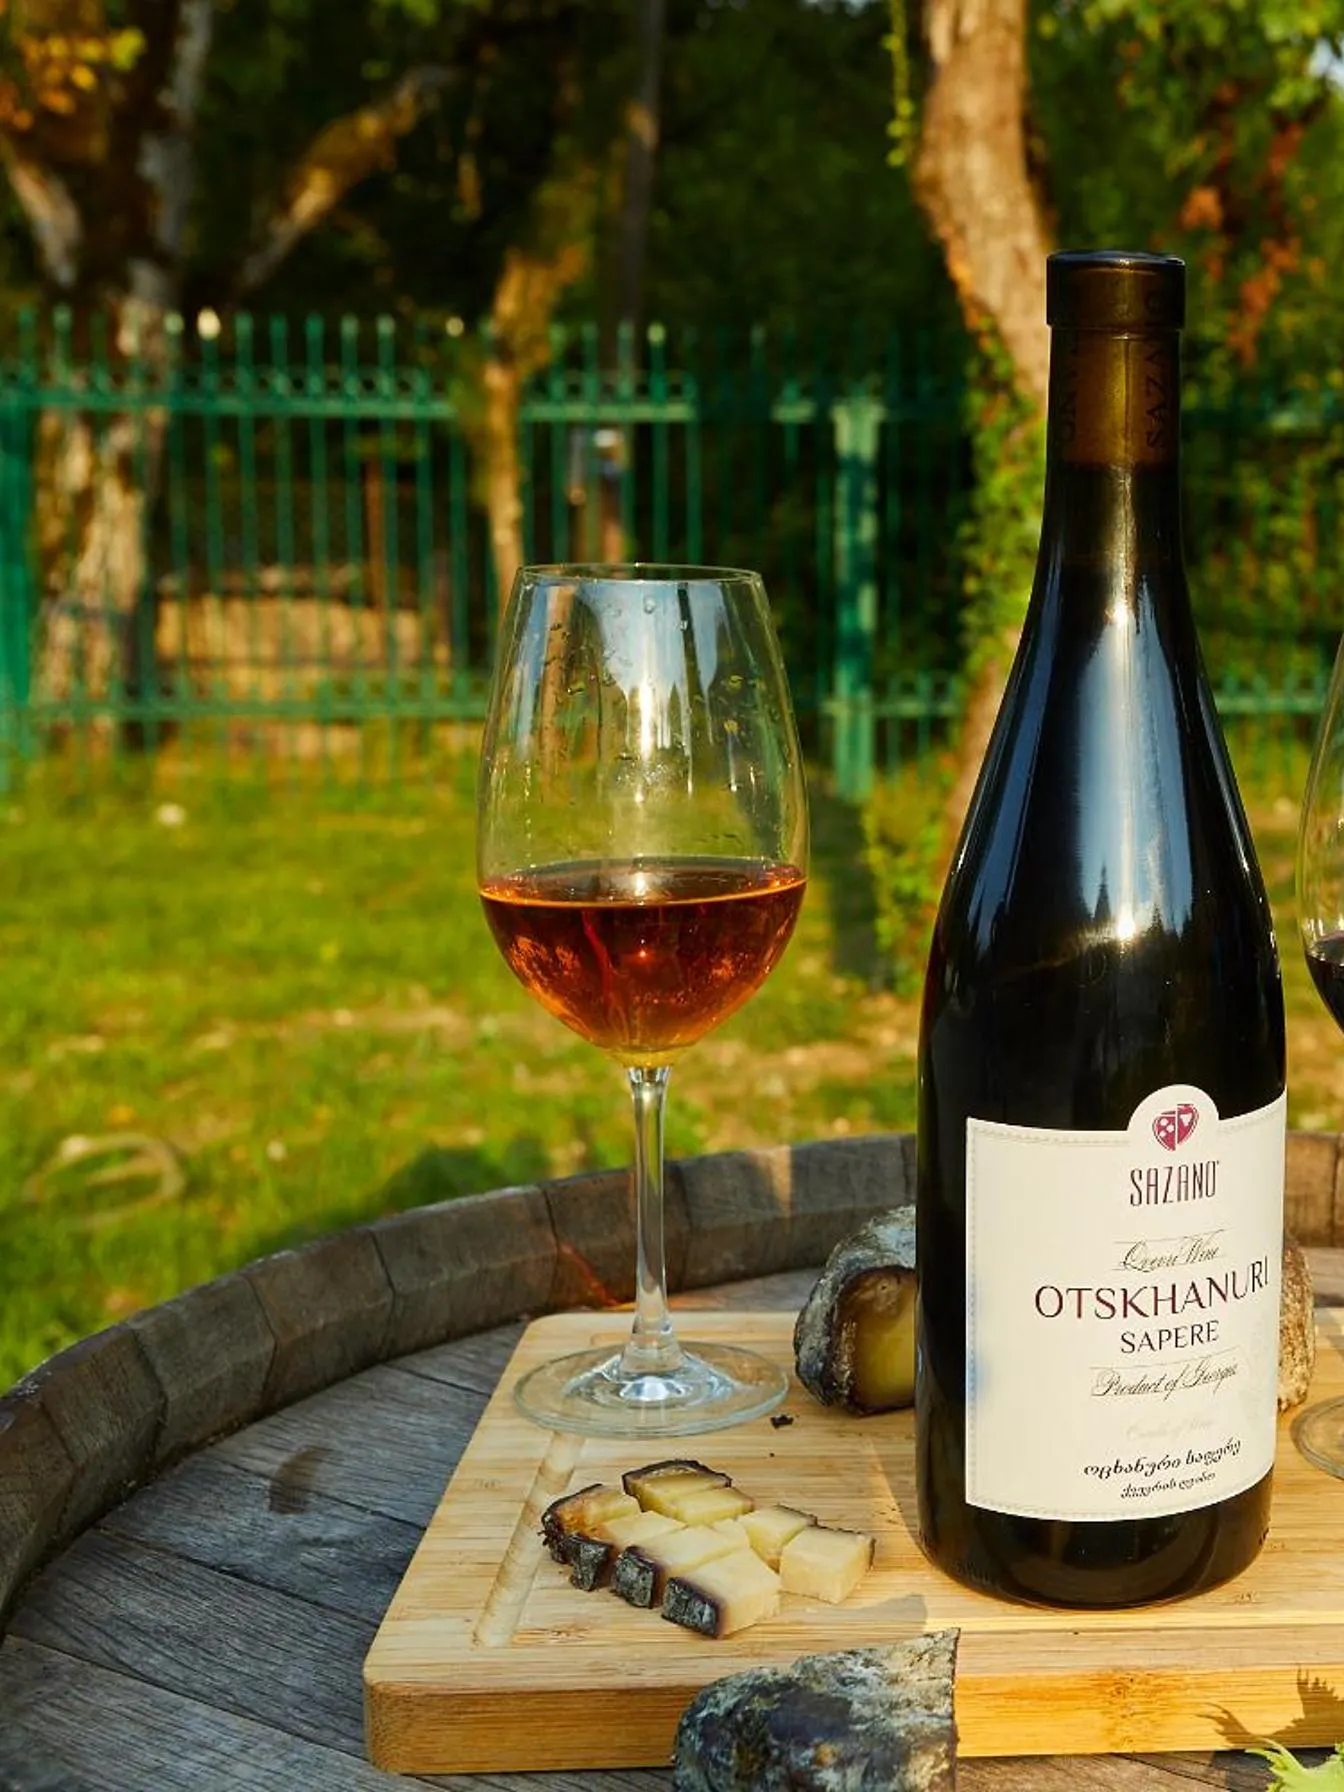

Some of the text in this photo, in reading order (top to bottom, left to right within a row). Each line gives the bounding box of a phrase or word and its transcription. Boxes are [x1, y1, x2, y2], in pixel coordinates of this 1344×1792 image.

[1130, 1160, 1217, 1206] SAZANO
[1034, 1255, 1269, 1320] OTSKHANURI
[1120, 1320, 1220, 1354] SAPERE
[1094, 1367, 1166, 1396] Product
[1165, 1363, 1190, 1401] of
[1083, 1453, 1182, 1480] ოცხანური
